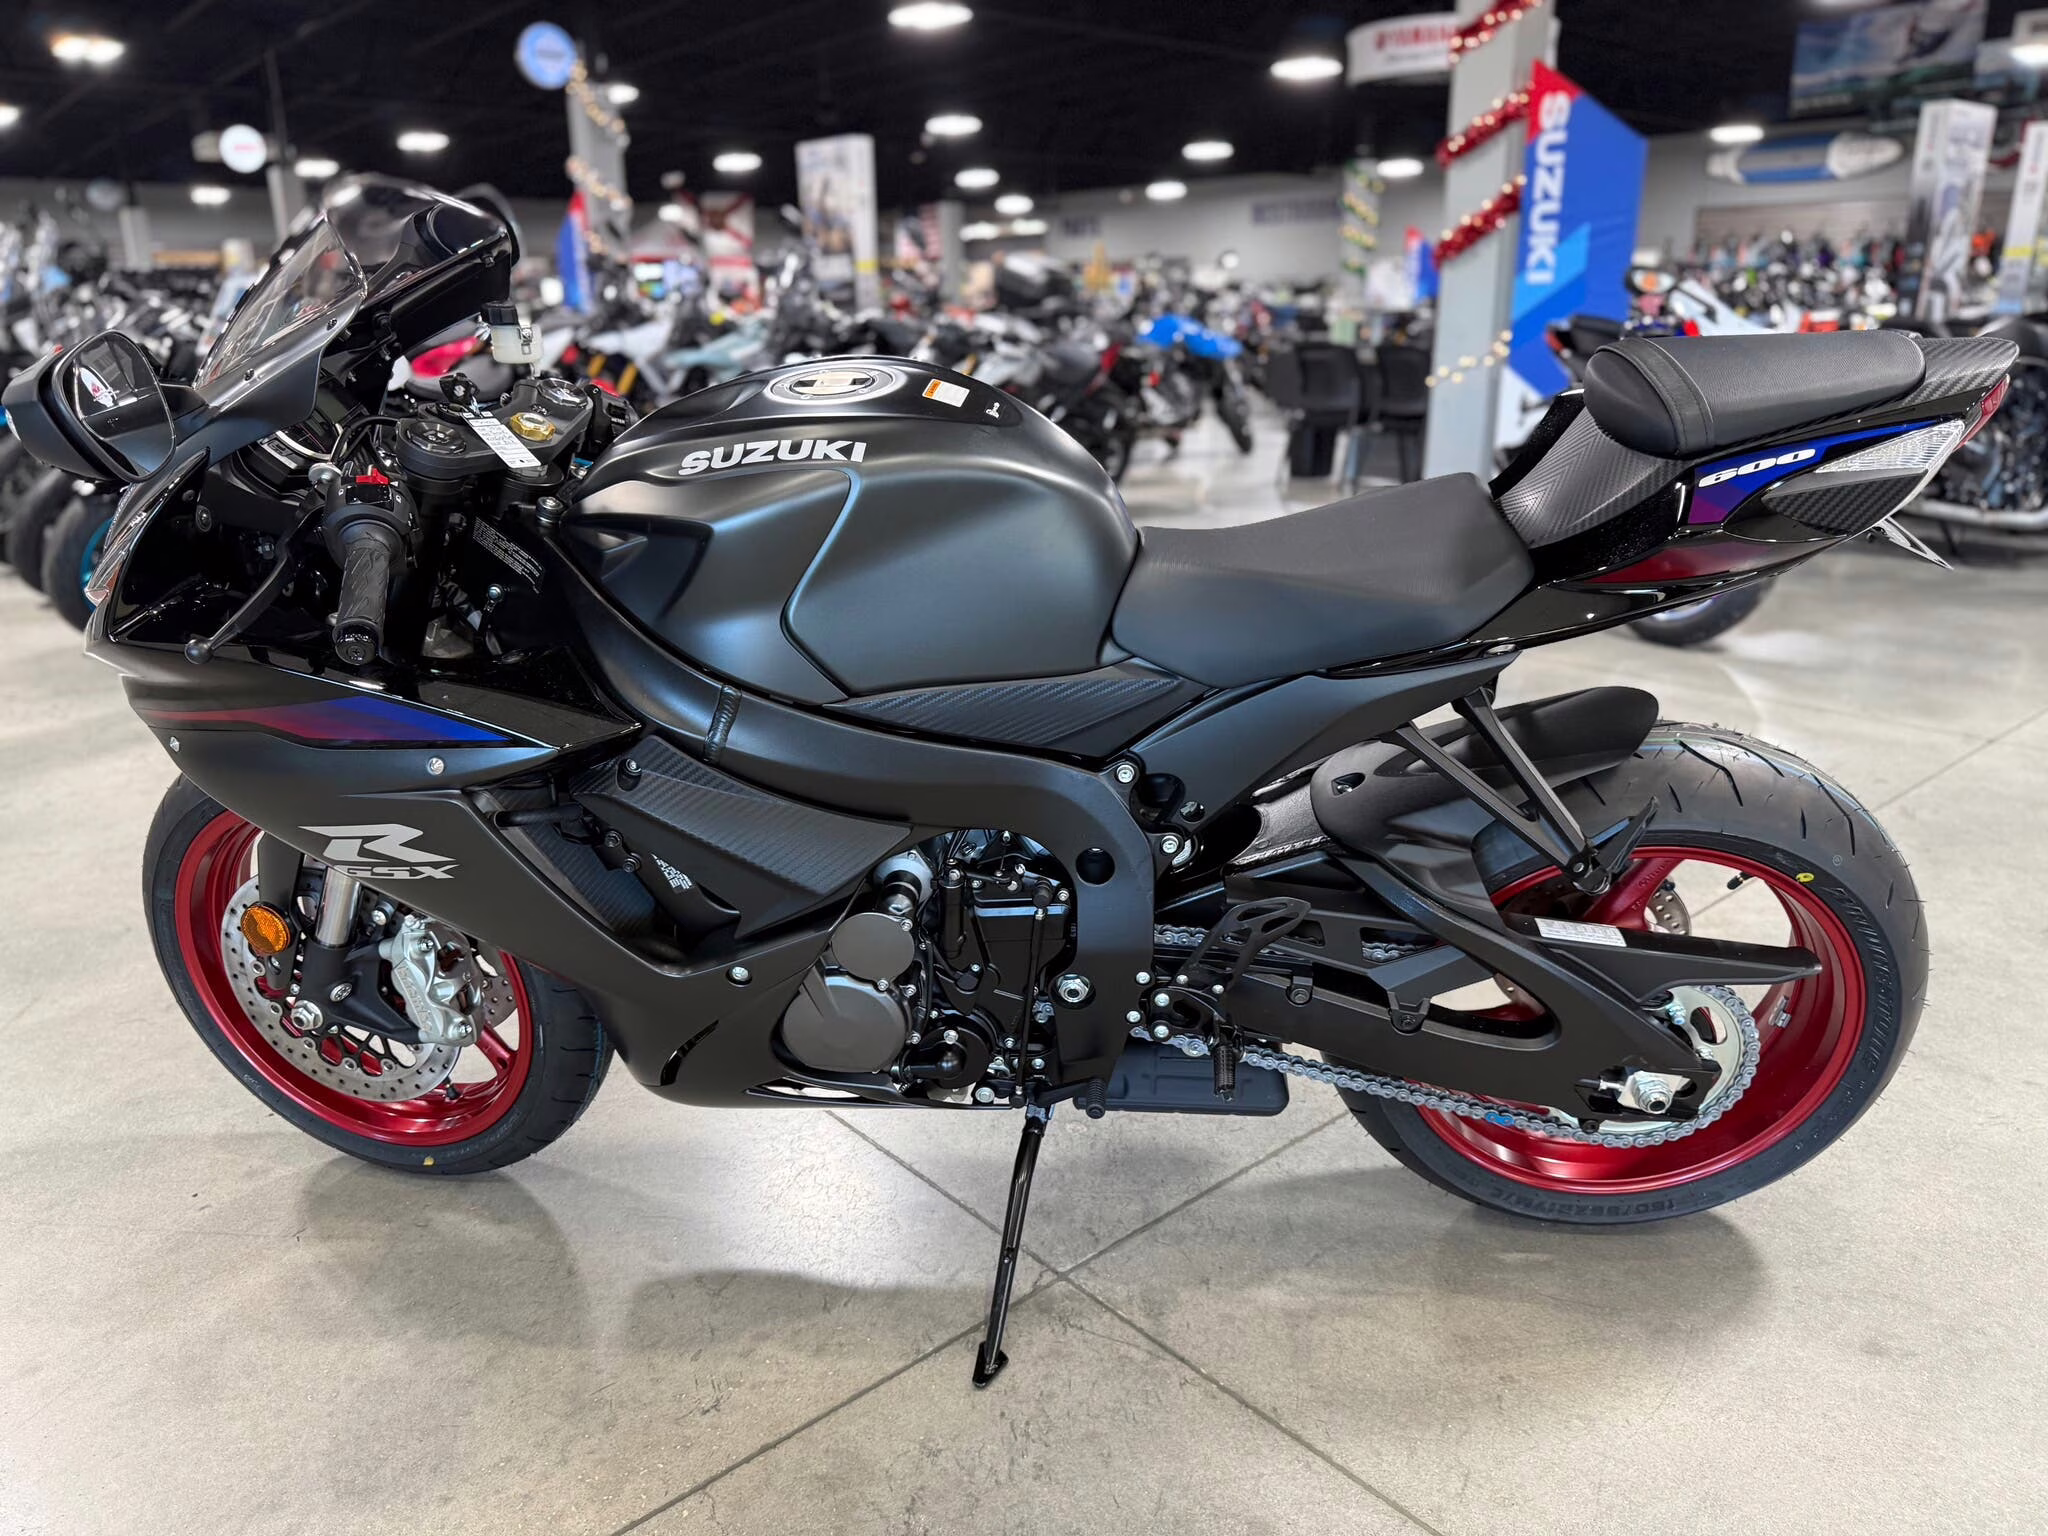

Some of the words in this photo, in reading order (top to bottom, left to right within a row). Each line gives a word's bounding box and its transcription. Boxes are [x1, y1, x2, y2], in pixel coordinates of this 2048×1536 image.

[1524, 91, 1572, 285] SUZUKI
[679, 440, 866, 476] SUZUKI
[1698, 449, 1816, 488] 600
[298, 824, 456, 863] R
[333, 864, 461, 880] GSX
